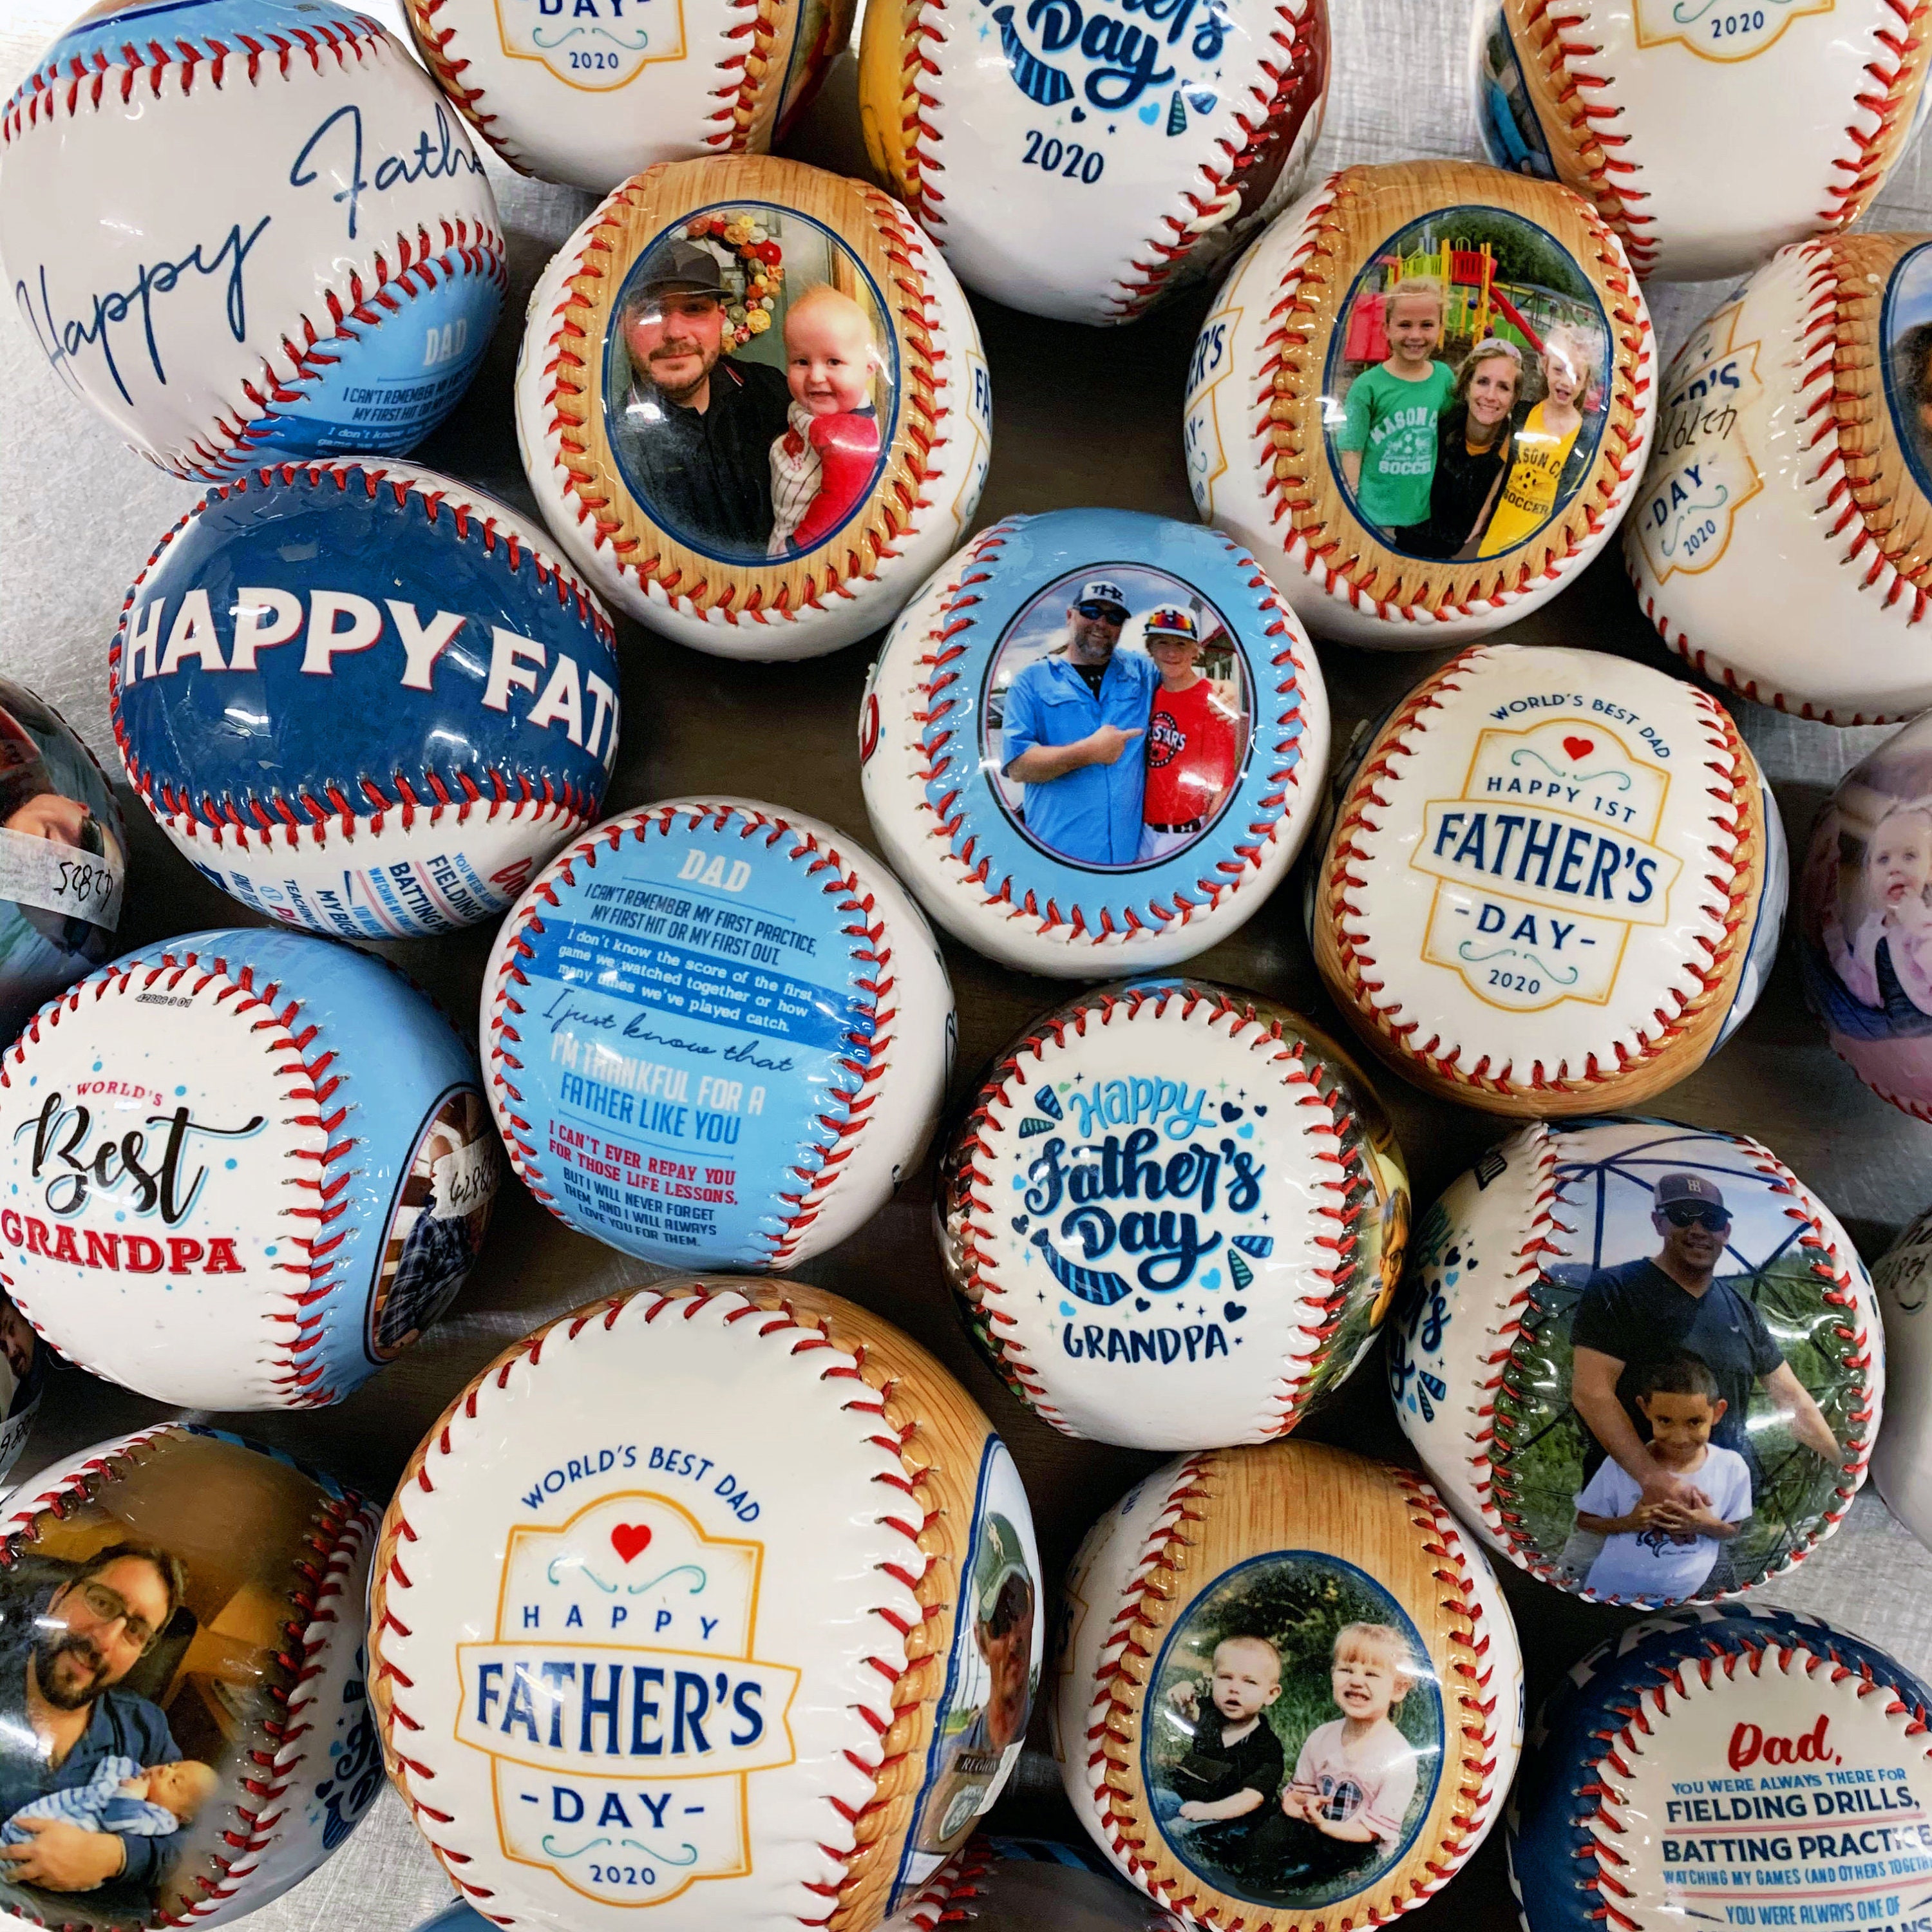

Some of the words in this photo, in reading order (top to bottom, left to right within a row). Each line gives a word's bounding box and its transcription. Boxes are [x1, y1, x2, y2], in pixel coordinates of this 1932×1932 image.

[1711, 10, 1764, 39] 2020
[569, 52, 619, 69] 2020
[1027, 0, 1175, 110] Day
[1022, 129, 1104, 184] 2020
[16, 216, 271, 406] Happy
[423, 319, 466, 366] DAD
[343, 387, 349, 402] I
[350, 388, 384, 404] CAN'T
[352, 407, 370, 421] MY
[370, 408, 402, 422] FIRST
[402, 406, 417, 420] HIT
[328, 427, 336, 436] I
[337, 428, 370, 439] don't
[1683, 519, 1716, 556] 2020
[126, 587, 467, 691] HAPPY
[482, 623, 620, 772] FAT
[1489, 692, 1584, 721] WORLD'S
[1591, 698, 1638, 725] BEST
[1638, 724, 1671, 760] DAD
[1487, 775, 1581, 803] HAPPY
[1593, 795, 1636, 824] 1ST
[453, 851, 471, 874] YOU
[677, 849, 752, 893] DAD
[1433, 812, 1658, 907] FATHER'S
[283, 879, 319, 925] TEACHING
[316, 890, 345, 911] MY
[368, 867, 399, 909] WATCHING
[388, 861, 441, 930] BATTING
[426, 854, 482, 925] FIELDING
[585, 884, 592, 898] I
[592, 884, 625, 904] CAN'T
[625, 889, 691, 920] REMEMBER
[693, 905, 713, 922] MY
[714, 909, 753, 934] FIRST
[754, 921, 817, 957] PRACTICE,
[591, 904, 611, 923] MY
[611, 909, 647, 931] FIRST
[645, 914, 667, 934] HIT
[667, 920, 690, 940] OR
[689, 926, 710, 946] MY
[711, 931, 752, 958] FIRST
[558, 943, 591, 963] game
[596, 953, 615, 967] we
[621, 960, 683, 986] watched
[687, 976, 751, 1004] together
[755, 994, 772, 1007] or
[778, 999, 810, 1018] how
[567, 927, 576, 940] I
[576, 929, 610, 949] don't
[612, 936, 652, 959] know
[657, 951, 681, 967] the
[685, 960, 726, 979] score
[732, 971, 750, 985] of
[755, 974, 779, 992] the
[782, 982, 813, 1001] first
[1488, 969, 1541, 996] 2020
[177, 998, 193, 1008] 01
[542, 988, 574, 1019] I
[551, 1003, 616, 1033] just
[641, 982, 685, 1007] we've
[690, 997, 742, 1021] played
[746, 1013, 790, 1032] catch.
[623, 1012, 717, 1056] know
[724, 1040, 795, 1072] that
[77, 1080, 162, 1107] WORLD'S
[551, 1032, 578, 1070] I'M
[582, 1041, 689, 1104] THANKFUL
[697, 1075, 743, 1113] FOR
[748, 1085, 766, 1115] A
[560, 1072, 634, 1124] FATHER
[639, 1099, 688, 1138] LIKE
[695, 1109, 741, 1145] YOU
[1068, 1075, 1218, 1141] Happy
[14, 1092, 268, 1228] Best
[549, 1119, 554, 1135] I
[559, 1124, 600, 1155] CAN'T
[605, 1143, 641, 1170] EVER
[648, 1157, 697, 1182] REPAY
[705, 1168, 736, 1186] YOU
[549, 1138, 572, 1162] FOR
[576, 1151, 621, 1182] THOSE
[627, 1171, 659, 1193] LIFE
[1025, 1128, 1266, 1215] Father's
[564, 1166, 585, 1187] BUT
[585, 1177, 591, 1191] I
[593, 1180, 621, 1203] WILL
[625, 1194, 663, 1213] NEVER
[667, 1203, 715, 1222] FORGET
[564, 1182, 592, 1206] THEM
[598, 1198, 621, 1218] AND
[624, 1208, 630, 1220] I
[632, 1210, 662, 1229] WILL
[665, 1218, 717, 1236] ALWAYS
[1, 1209, 245, 1274] GRANDPA
[578, 1204, 605, 1224] LOVE
[610, 1218, 634, 1234] YOU
[636, 1226, 659, 1240] FOR
[1060, 1206, 1222, 1296] Day
[1063, 1323, 1229, 1364] GRANDPA
[521, 1444, 637, 1511] WORLD'S
[648, 1445, 714, 1483] BEST
[714, 1472, 761, 1524] DAD
[522, 1605, 719, 1641] HAPPY
[476, 1662, 766, 1757] FATHER'S
[1728, 1714, 1842, 1772] Dad,
[1665, 1794, 1808, 1823] FIELDING
[1812, 1786, 1920, 1816] DRILLS,
[1672, 1781, 1704, 1795] YOU
[1707, 1778, 1754, 1794] WERE
[1760, 1774, 1822, 1791] ALWAYS
[1826, 1770, 1875, 1785] THERE
[1879, 1767, 1907, 1782] FOR
[1662, 1837, 1792, 1862] BATTING
[1663, 1870, 1728, 1886] WATCHING
[1732, 1871, 1751, 1886] MY
[1756, 1868, 1801, 1886] GAMES
[1804, 1866, 1837, 1884] (AND
[1839, 1861, 1886, 1881] OTHERS
[589, 1864, 656, 1886] 2020
[1725, 1904, 1755, 1926] YOU
[1758, 1904, 1797, 1926] WERE
[1801, 1902, 1855, 1926] ALWAYS
[1857, 1898, 1884, 1921] ONE
[1886, 1895, 1900, 1916] OF
